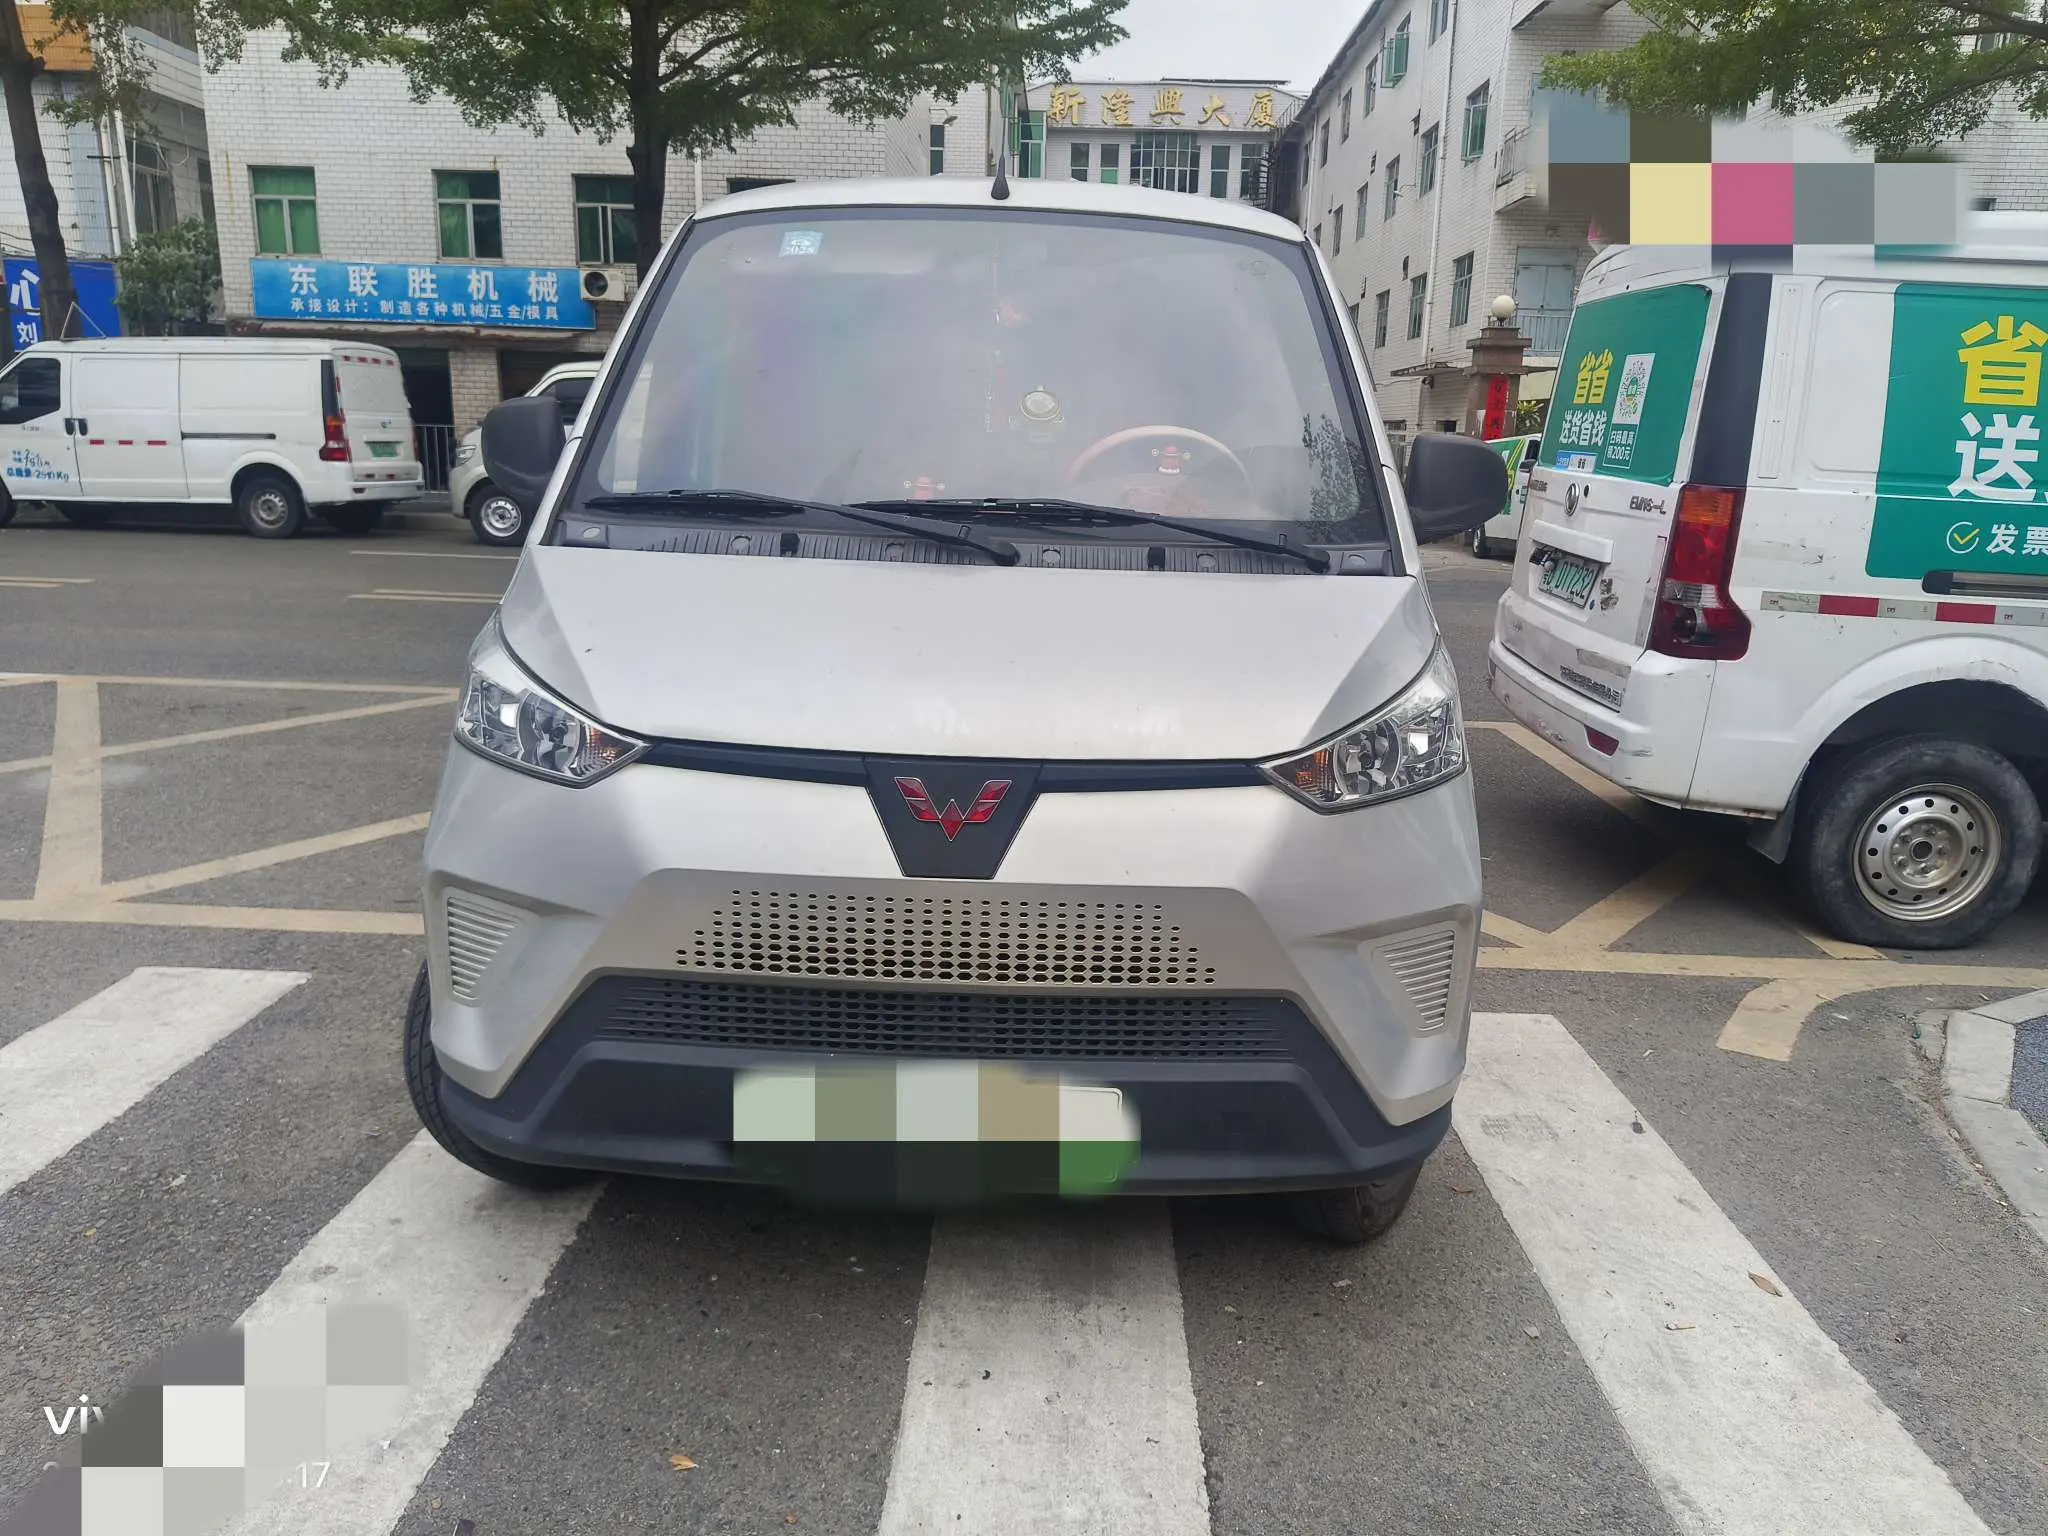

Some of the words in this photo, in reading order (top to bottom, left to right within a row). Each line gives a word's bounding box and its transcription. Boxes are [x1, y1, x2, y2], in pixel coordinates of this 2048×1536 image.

[288, 264, 559, 302] 东联胜机械
[16, 322, 39, 344] 刘
[1573, 349, 1614, 405] 省省
[1958, 315, 2048, 406] 省
[1559, 409, 1608, 447] 送货省钱
[1985, 523, 2048, 556] 发票
